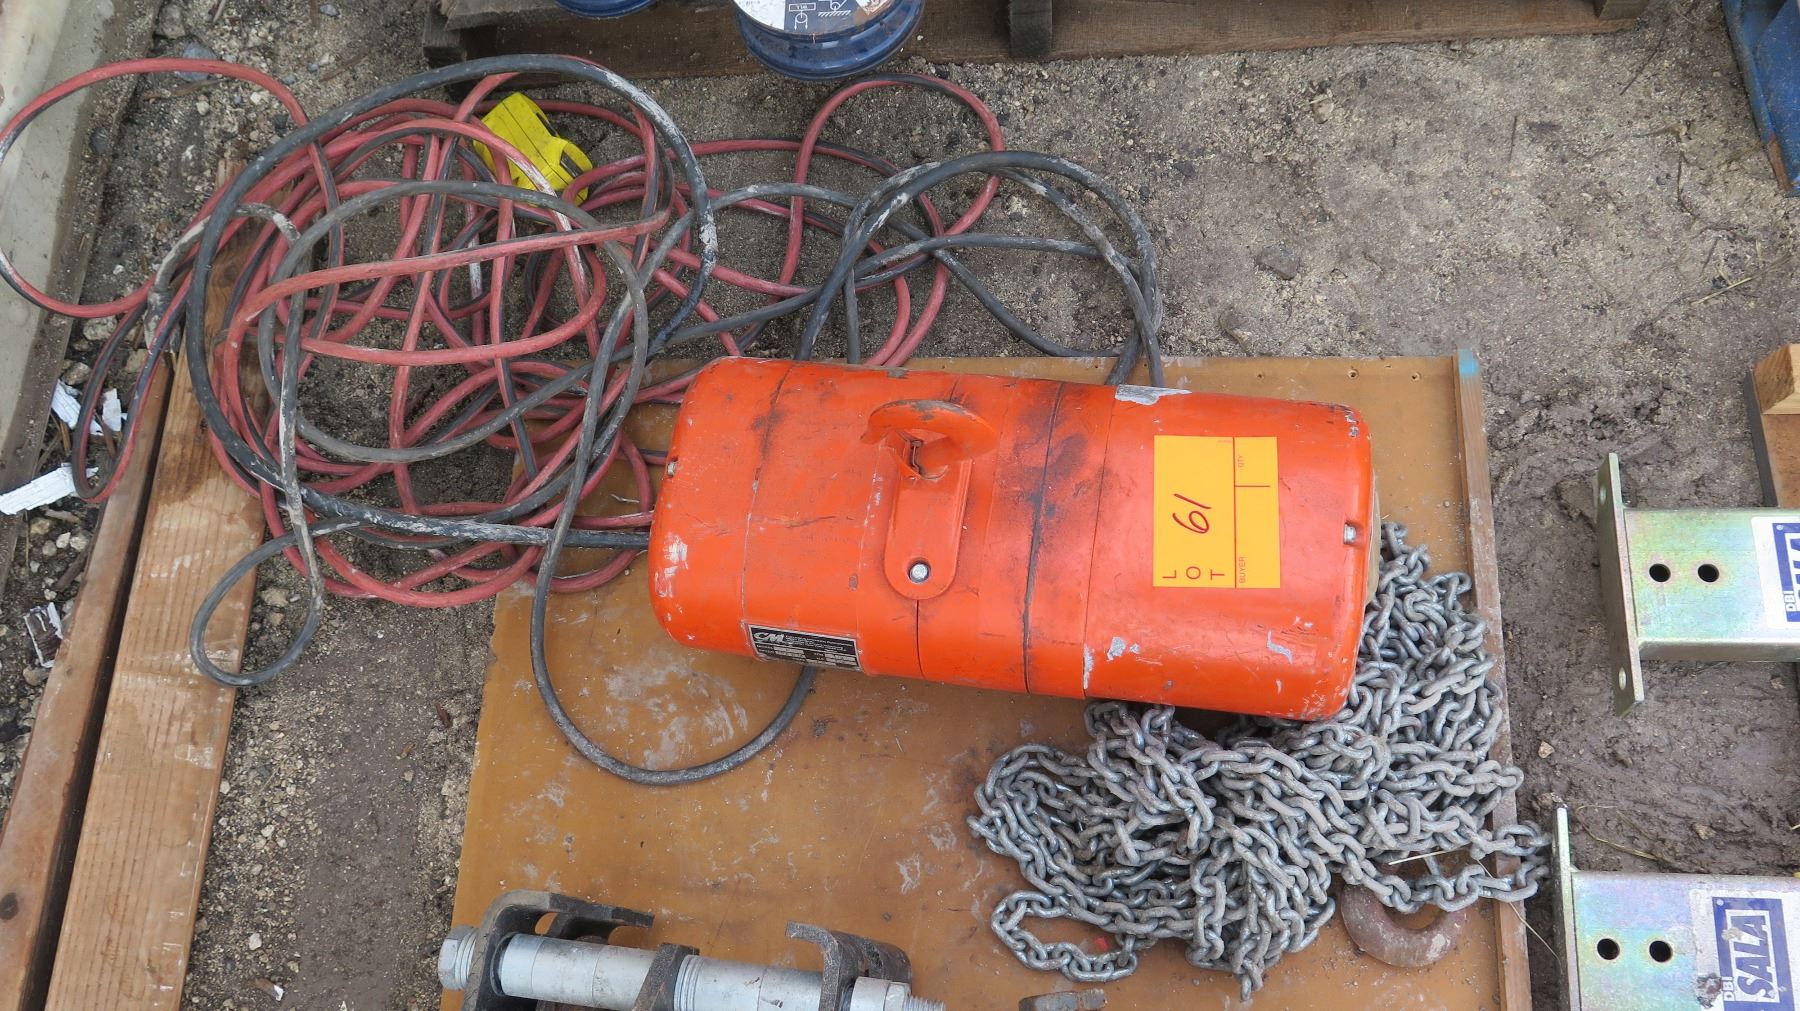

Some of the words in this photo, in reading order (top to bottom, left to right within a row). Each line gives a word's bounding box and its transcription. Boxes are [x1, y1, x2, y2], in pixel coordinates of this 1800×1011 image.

[1237, 454, 1245, 468] QTY
[1172, 493, 1212, 534] 61
[1238, 556, 1246, 584] BUYER
[1783, 590, 1797, 612] DBI
[753, 632, 785, 643] CM
[1729, 915, 1775, 999] SALA
[1722, 977, 1736, 1001] DBI
